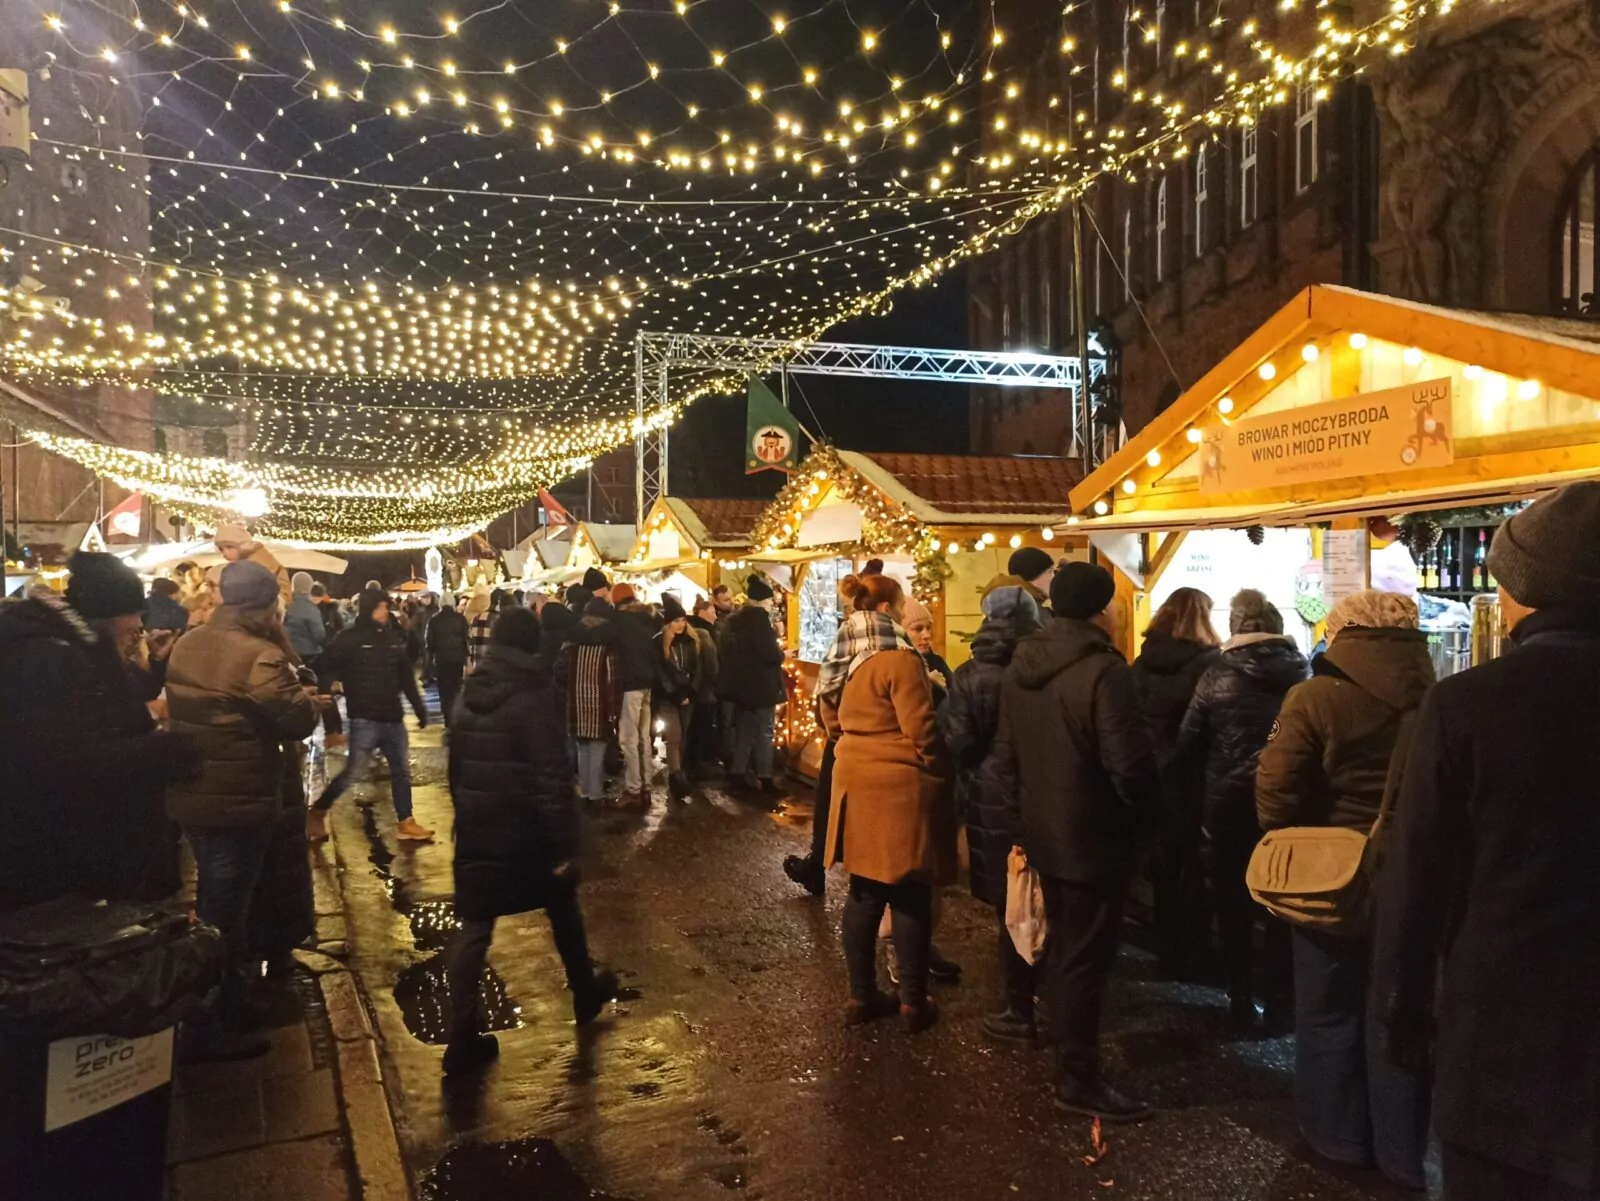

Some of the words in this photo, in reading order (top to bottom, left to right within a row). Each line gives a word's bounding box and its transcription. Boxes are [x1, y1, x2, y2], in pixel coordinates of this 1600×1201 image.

[1238, 424, 1289, 446] BROWAR
[1292, 405, 1389, 437] MOCZYBRODA
[1251, 446, 1284, 462] WINO
[1293, 435, 1324, 456] MIÓD
[1329, 429, 1371, 450] PITNY
[76, 1046, 134, 1077] zero
